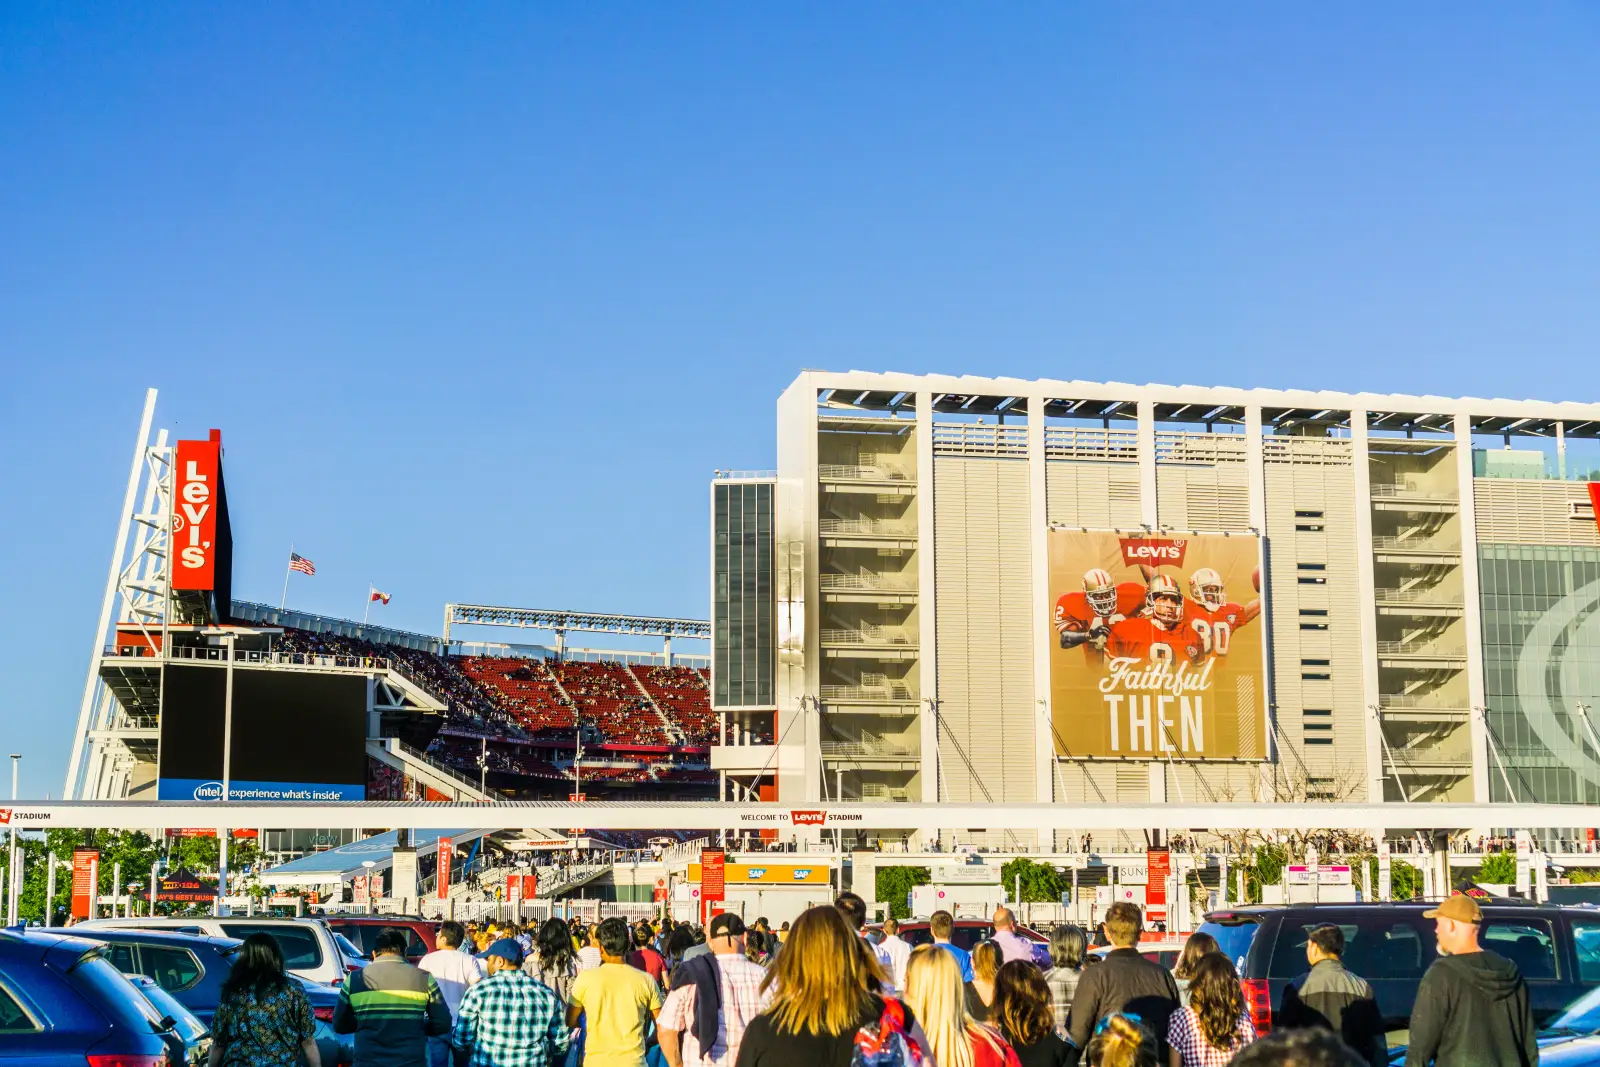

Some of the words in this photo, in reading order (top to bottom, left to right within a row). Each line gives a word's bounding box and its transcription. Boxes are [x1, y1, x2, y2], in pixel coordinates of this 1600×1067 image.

[1099, 655, 1216, 697] Faithful
[1103, 694, 1204, 752] THEN
[229, 789, 281, 799] experience
[282, 789, 311, 799] what's
[309, 834, 338, 845] view
[749, 870, 764, 878] SAP
[794, 871, 808, 879] SAP
[144, 893, 174, 901] TDAY'S
